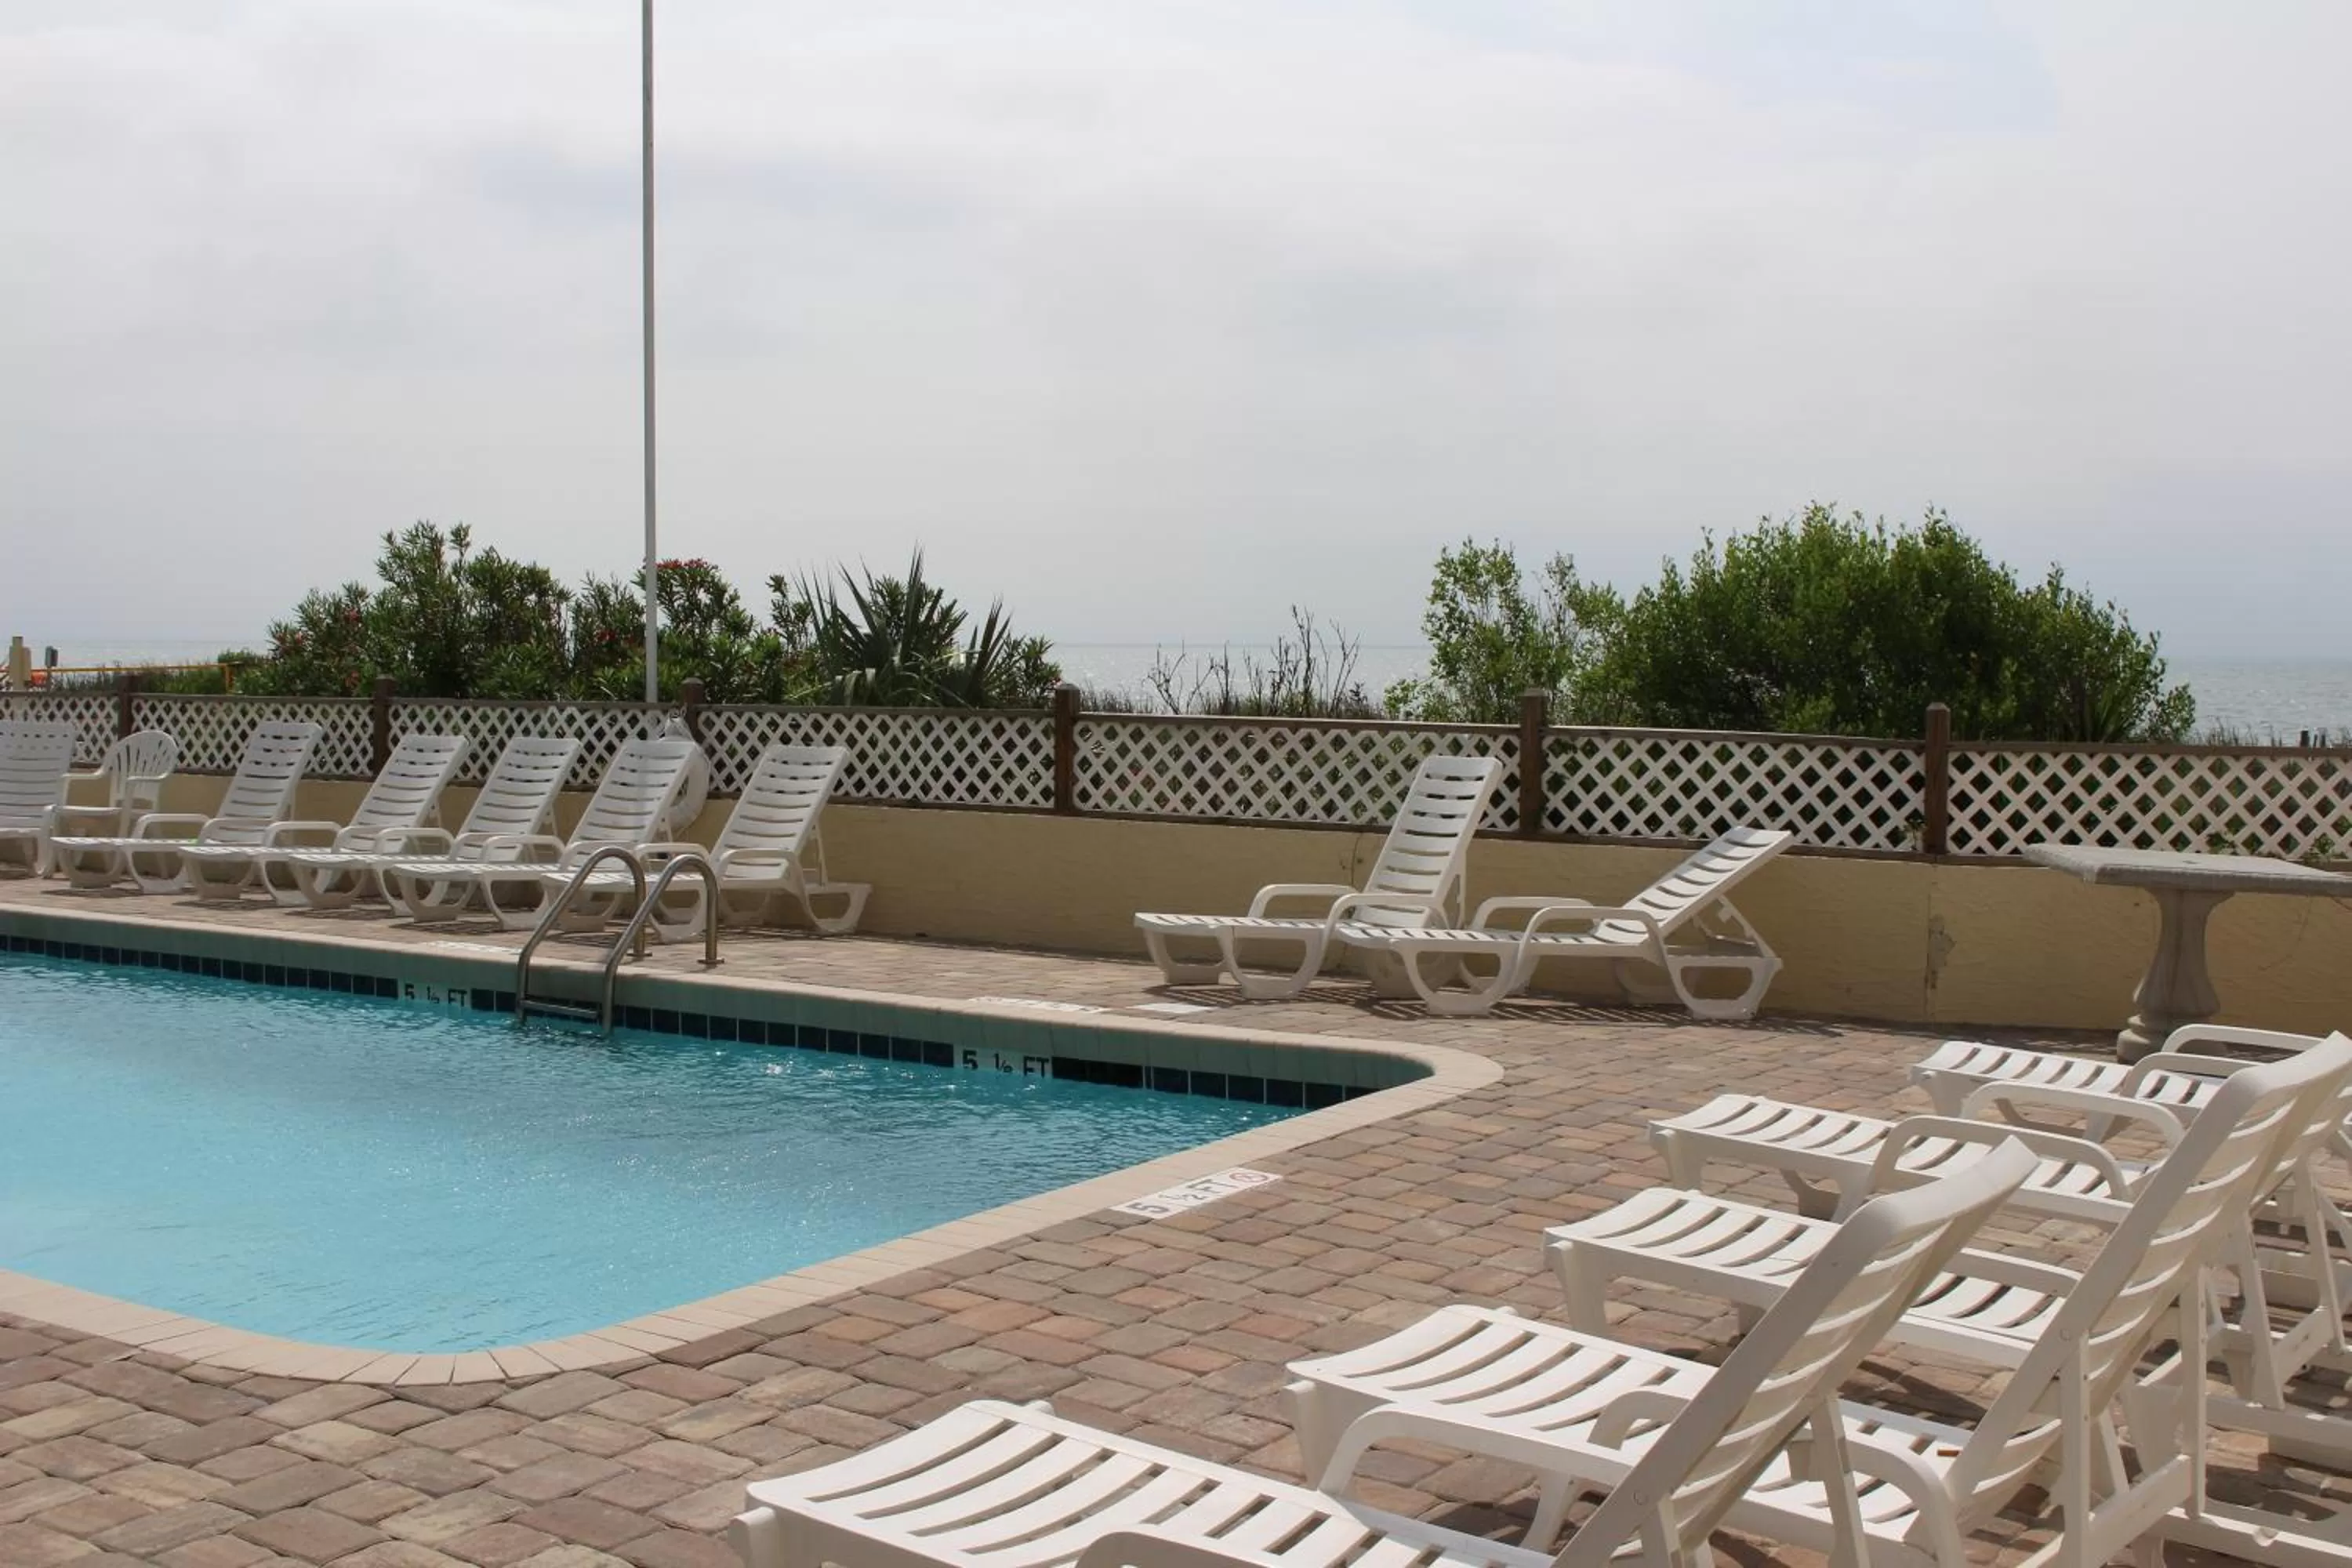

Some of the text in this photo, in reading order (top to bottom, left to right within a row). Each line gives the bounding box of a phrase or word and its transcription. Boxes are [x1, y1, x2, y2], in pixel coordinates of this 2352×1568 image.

[405, 983, 415, 1000] 5
[448, 988, 468, 1007] FT
[963, 1049, 978, 1070] 5
[1023, 1055, 1049, 1078] FT
[1126, 1201, 1170, 1214] 5
[1186, 1178, 1240, 1194] FT
